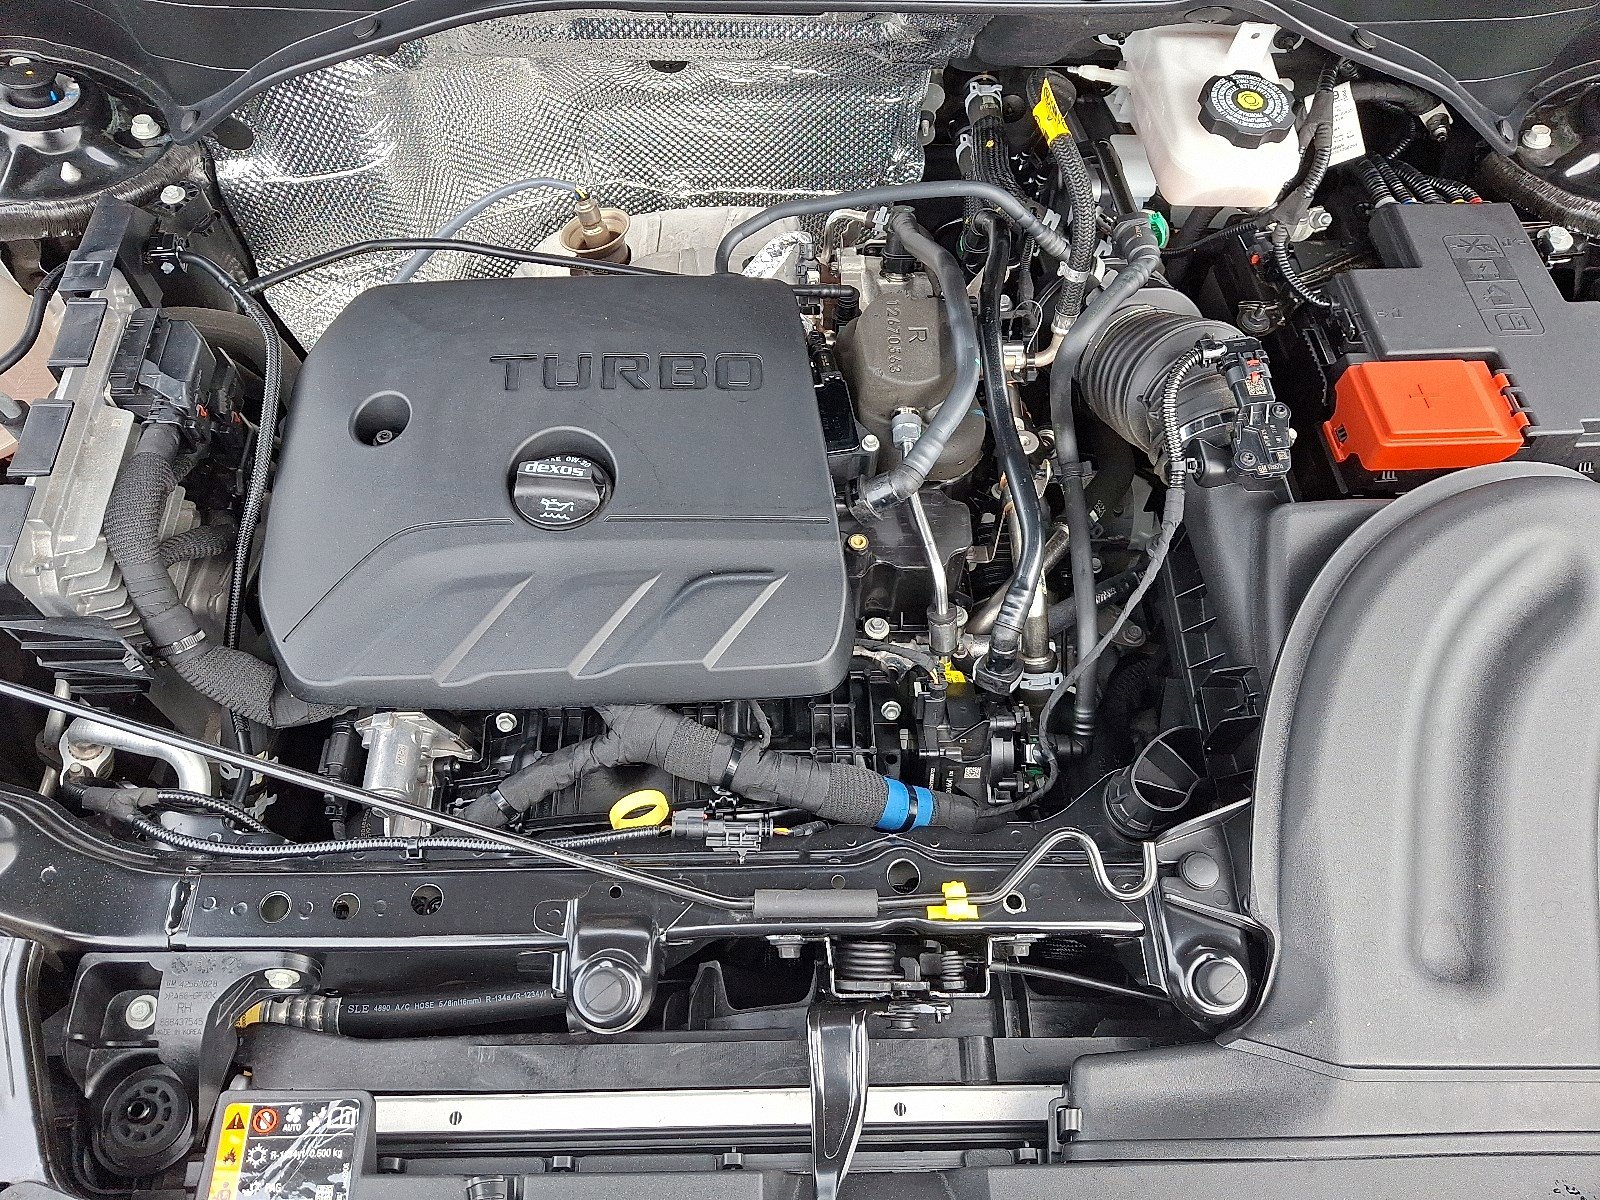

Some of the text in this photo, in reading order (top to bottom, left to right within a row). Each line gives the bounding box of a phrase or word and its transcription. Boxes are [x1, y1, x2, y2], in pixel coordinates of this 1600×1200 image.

[907, 326, 929, 343] R
[490, 353, 763, 391] TURBO
[524, 461, 585, 476] dexos
[177, 1002, 193, 1014] RH
[347, 1004, 370, 1014] SLE
[414, 1002, 434, 1010] HOSE
[282, 1124, 302, 1132] AUTO
[332, 1148, 343, 1158] kg
